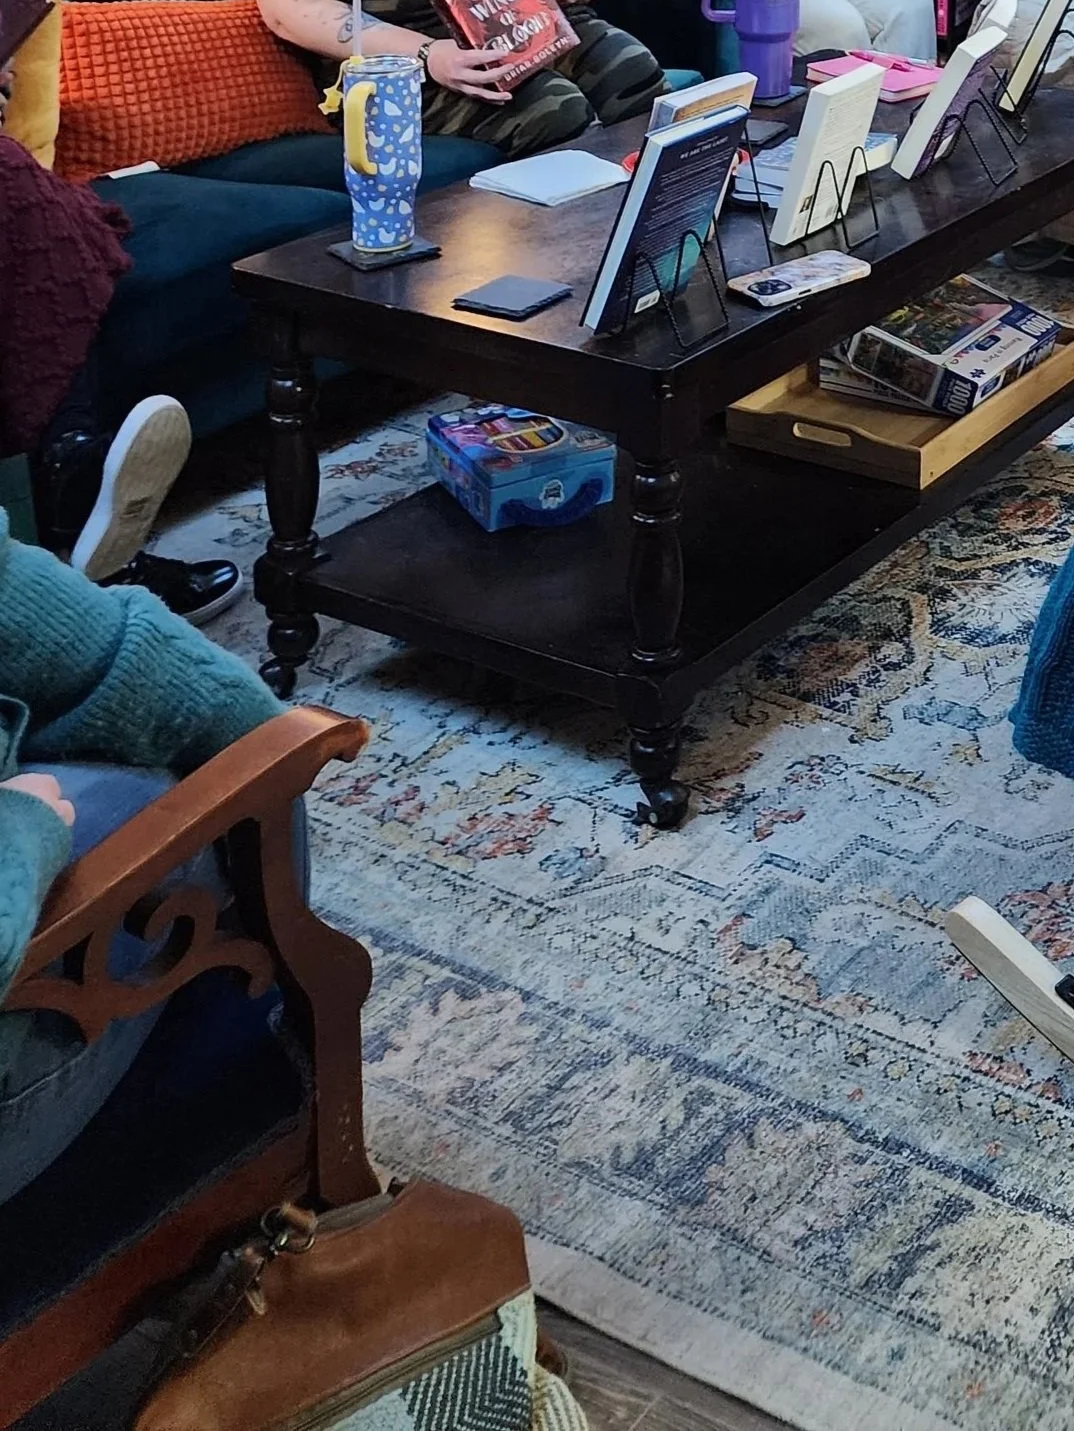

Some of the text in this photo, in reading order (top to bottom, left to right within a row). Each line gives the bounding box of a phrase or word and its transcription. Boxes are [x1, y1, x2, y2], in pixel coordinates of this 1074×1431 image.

[484, 12, 549, 53] BLOOD
[1019, 315, 1054, 336] 1000
[946, 379, 973, 415] 1000
